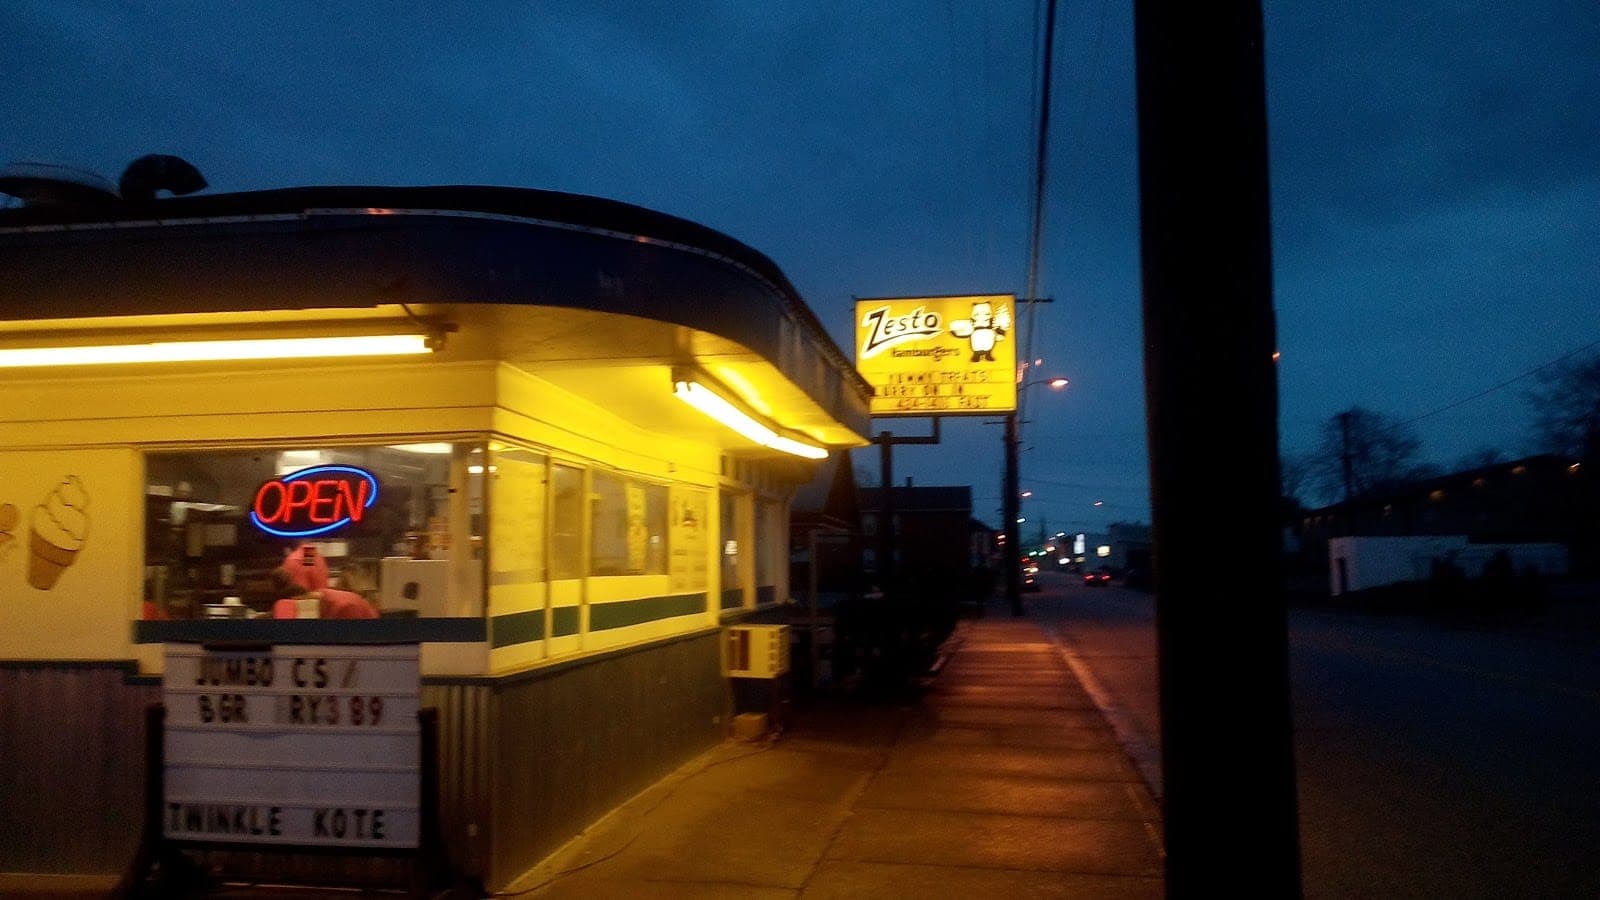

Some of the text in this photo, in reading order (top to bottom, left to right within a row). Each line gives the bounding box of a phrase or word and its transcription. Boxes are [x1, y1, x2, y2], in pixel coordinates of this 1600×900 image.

[867, 309, 938, 351] Zesto
[893, 346, 960, 361] hamburgers
[940, 370, 988, 382] TREATS
[255, 480, 368, 523] OPEN
[196, 658, 274, 686] JUMBO
[292, 657, 328, 688] CS
[198, 695, 248, 723] BGR
[168, 803, 384, 839] TWINKLE KOTE
